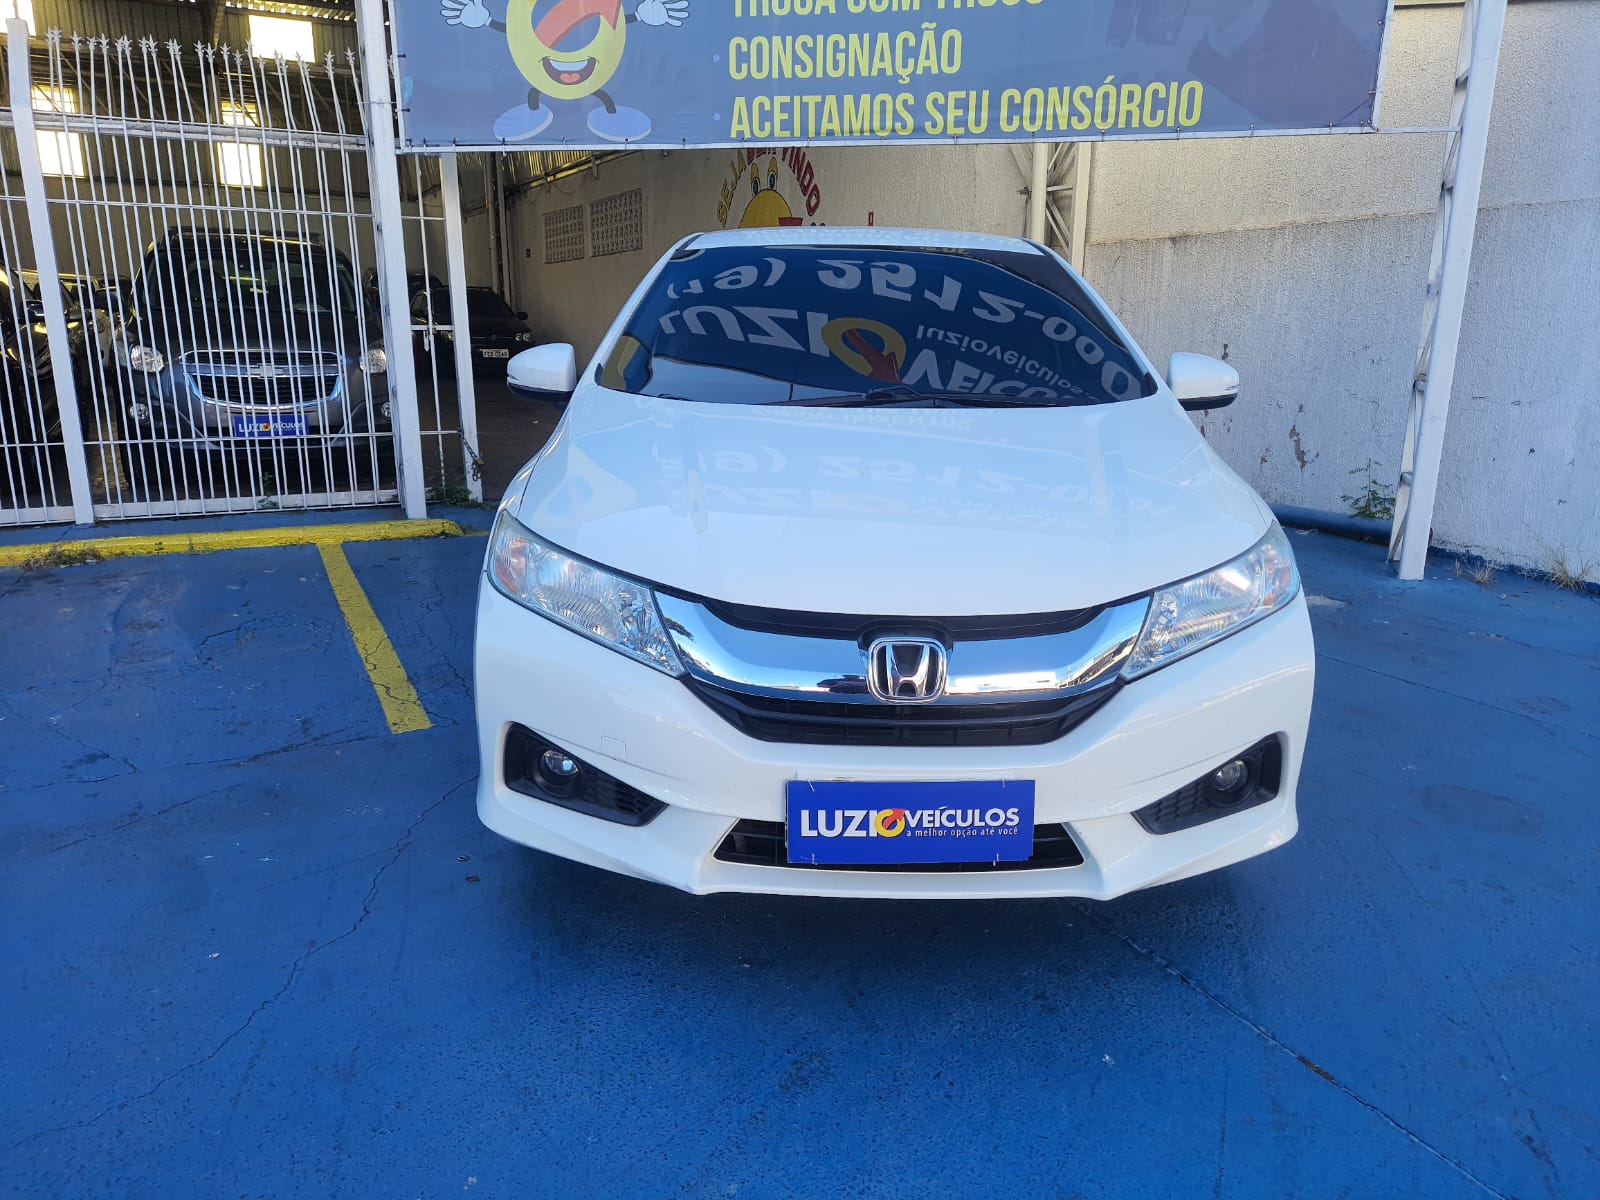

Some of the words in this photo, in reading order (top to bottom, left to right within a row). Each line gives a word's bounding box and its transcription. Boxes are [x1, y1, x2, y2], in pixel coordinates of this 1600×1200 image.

[728, 21, 963, 85] CONSIGNAÇÃO
[730, 92, 915, 139] ACEITAMOS
[924, 90, 990, 136] SEU
[999, 75, 1204, 133] CONSÓRCIO
[800, 808, 906, 838] LUZIO
[904, 805, 1020, 829] VEÍCULOS
[915, 827, 947, 838] melhor
[950, 828, 977, 839] opção
[980, 827, 995, 836] até
[998, 826, 1019, 836] você
